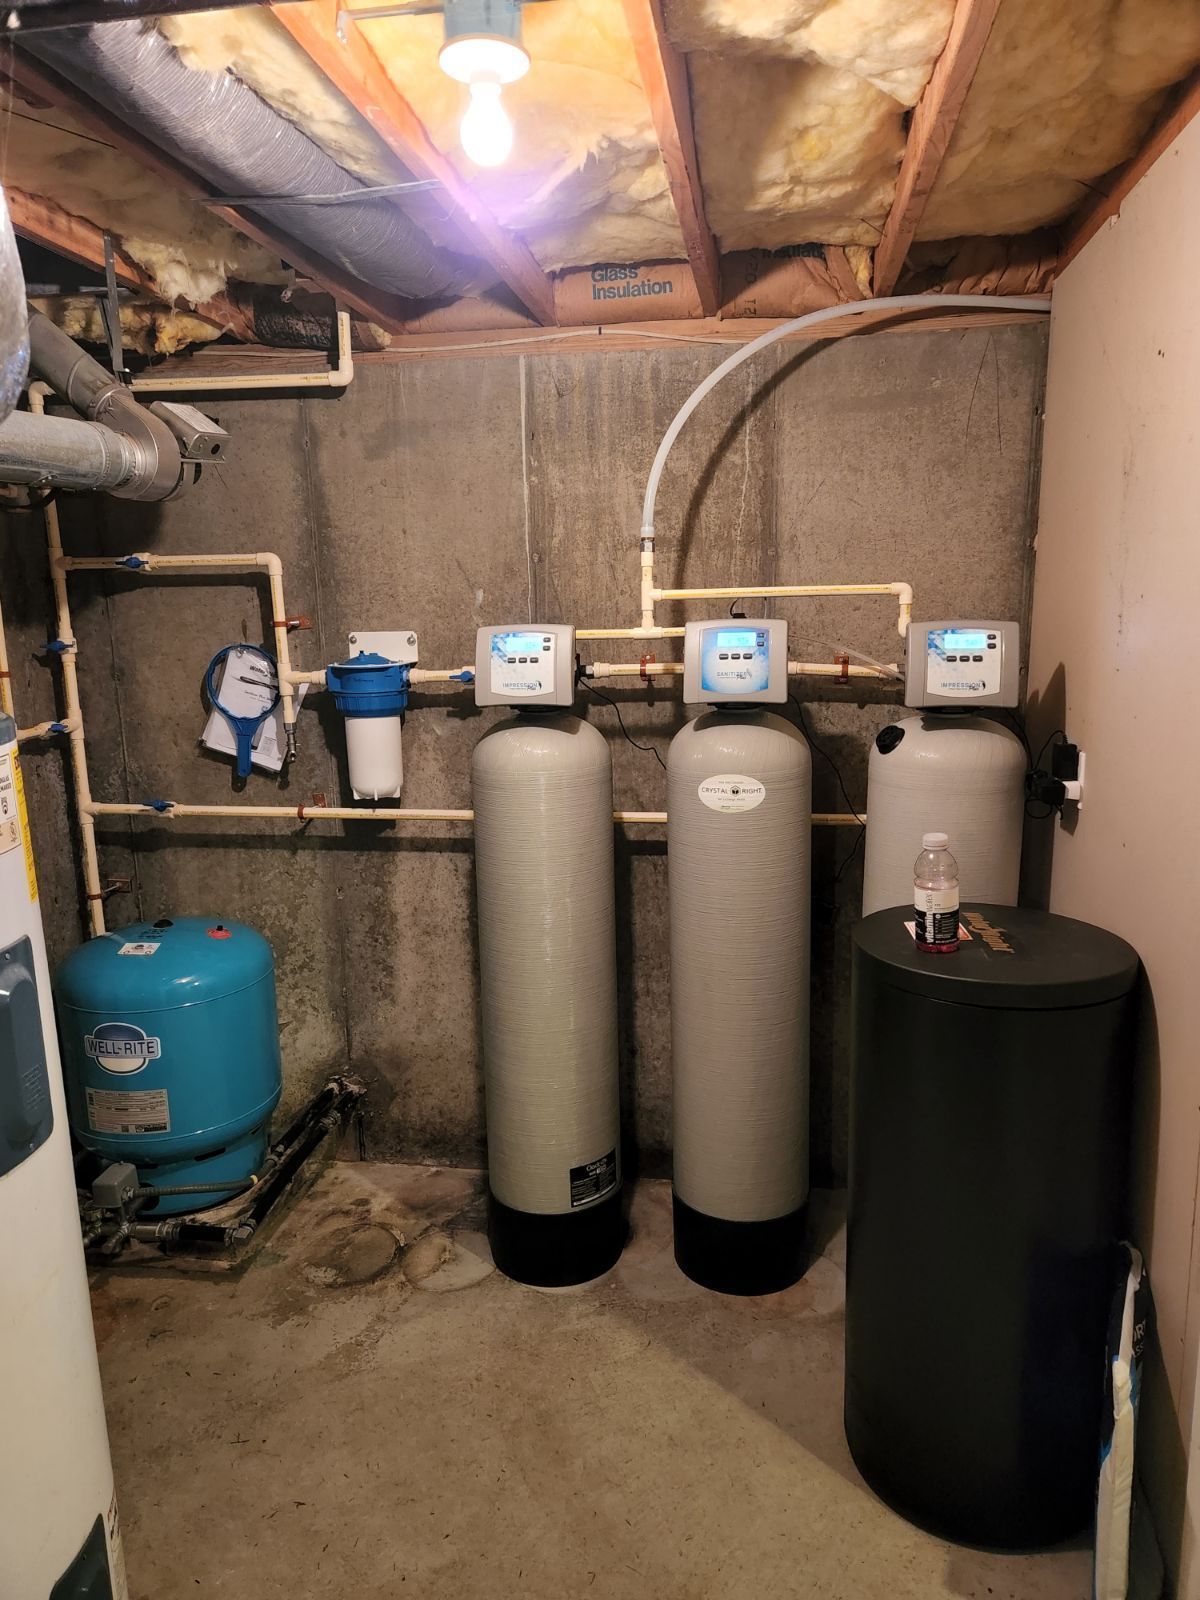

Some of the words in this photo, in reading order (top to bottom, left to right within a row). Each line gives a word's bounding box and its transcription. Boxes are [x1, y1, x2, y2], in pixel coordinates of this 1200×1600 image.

[591, 264, 638, 282] Glass
[592, 279, 673, 300] Insulation
[701, 787, 729, 795] CRYSTAL
[87, 1039, 155, 1055] WELL-RITE
